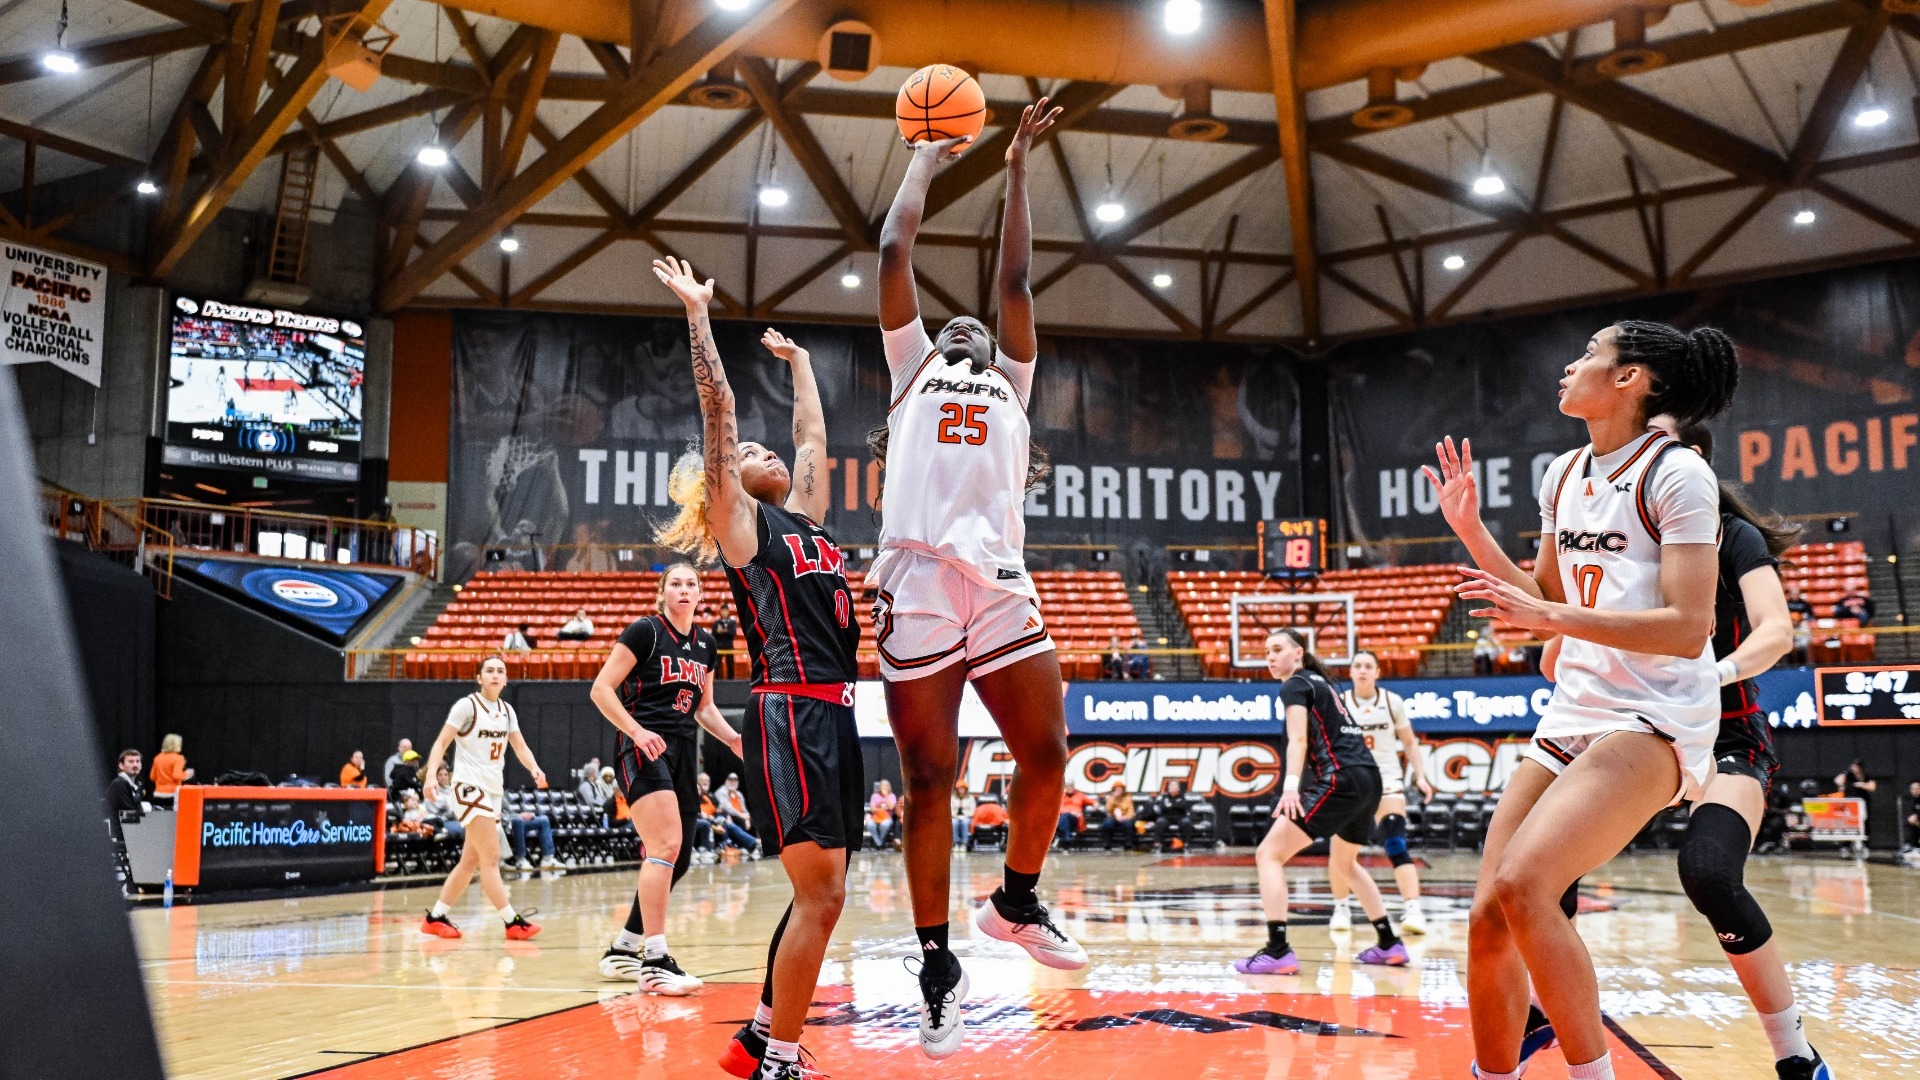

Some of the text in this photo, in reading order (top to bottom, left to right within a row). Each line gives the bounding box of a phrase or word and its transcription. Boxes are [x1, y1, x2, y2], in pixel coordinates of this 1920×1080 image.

[5, 246, 101, 281] UNIVERSITY
[33, 266, 70, 282] OF THE
[11, 270, 92, 304] PACIFIC
[3, 310, 94, 342] VOLLEYBALL
[28, 303, 72, 323] NCAA
[4, 337, 90, 365] CHAMPIONS
[11, 325, 84, 352] NATIONAL
[919, 377, 1009, 402] PACIFIC
[938, 402, 989, 445] 25
[190, 450, 216, 464] Best
[218, 453, 264, 468] Western
[265, 459, 293, 472] PLUS
[579, 449, 1282, 522] THI ERRITORY
[1379, 456, 1511, 518] HOE
[1284, 538, 1312, 568] 18
[1558, 528, 1629, 555] PACFIC
[782, 534, 849, 586] LM
[835, 589, 850, 629] 0
[661, 655, 708, 693] LMU
[1084, 695, 1149, 721] Learn
[1153, 695, 1271, 721] Basketball
[1402, 692, 1452, 719] cific
[1453, 691, 1529, 725] Tigers
[958, 738, 1281, 799] PCIFIC
[203, 820, 372, 847] Pacific HomeCare Services
